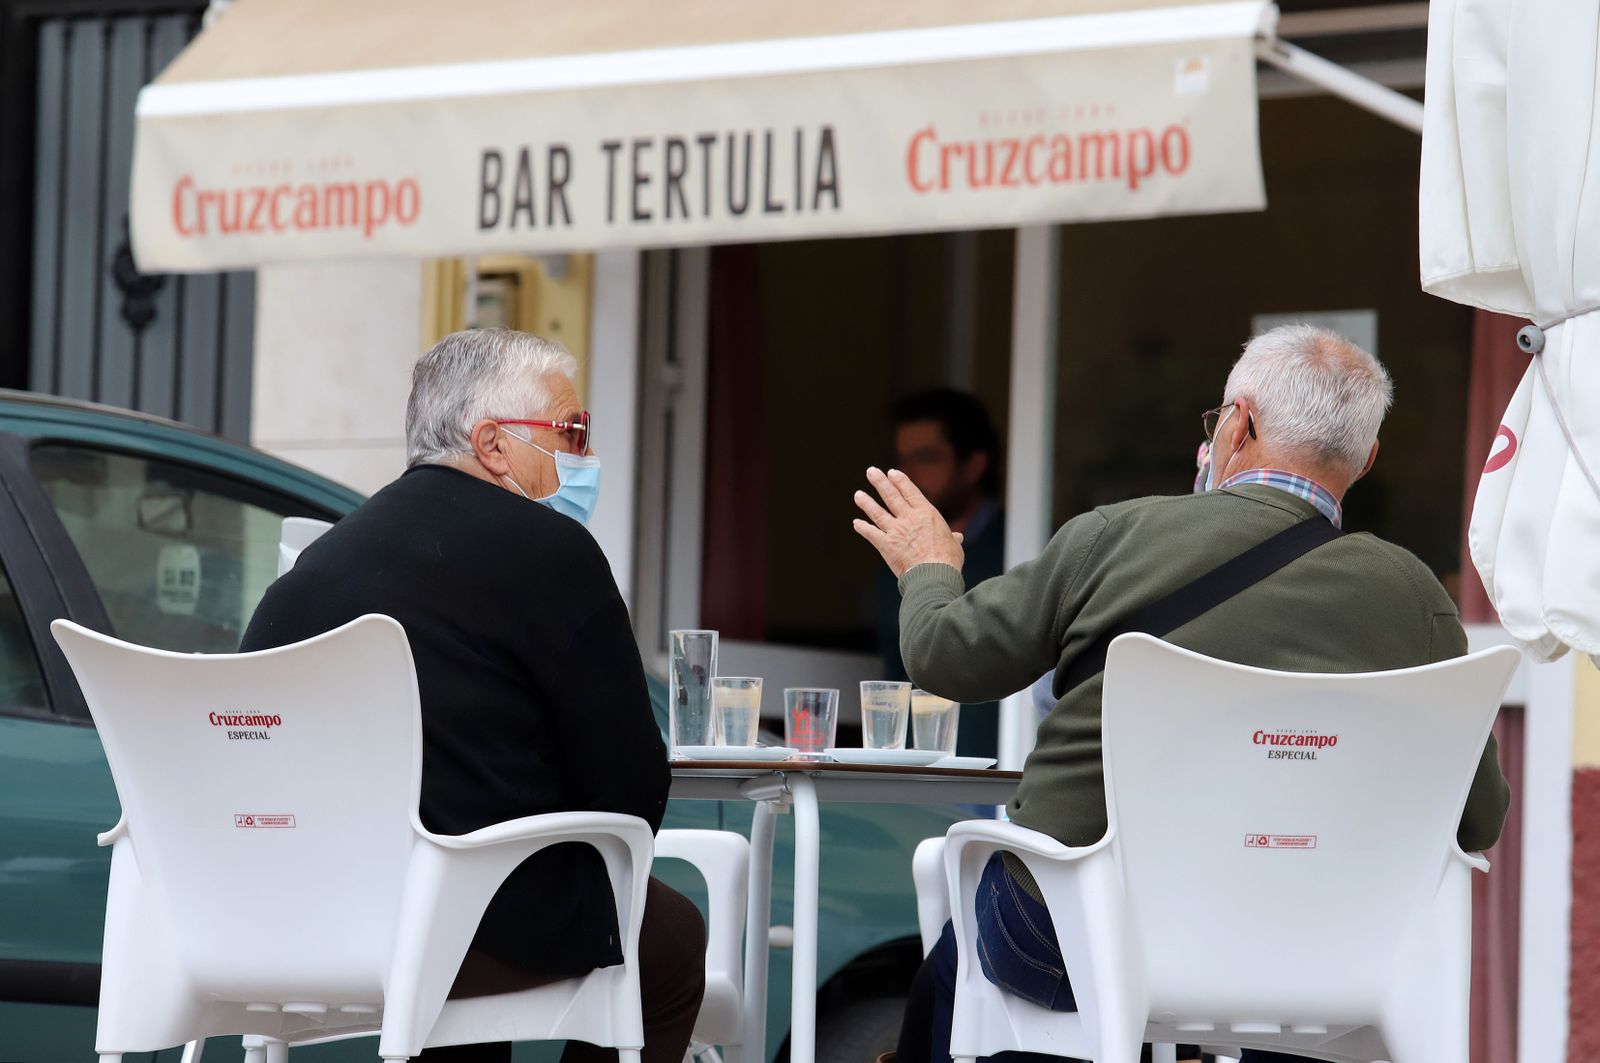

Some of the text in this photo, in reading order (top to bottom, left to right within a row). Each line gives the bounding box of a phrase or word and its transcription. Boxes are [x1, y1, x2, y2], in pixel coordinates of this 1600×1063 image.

[905, 122, 1191, 192] Cruzcampo
[478, 124, 841, 230] BAR TERTULIA
[172, 172, 421, 239] Cruzcampo
[209, 711, 281, 728] Cruzcampo
[227, 730, 270, 740] ESPECIAL
[1253, 730, 1338, 749] Cruzcampo
[1268, 750, 1318, 760] ESPECIAL
